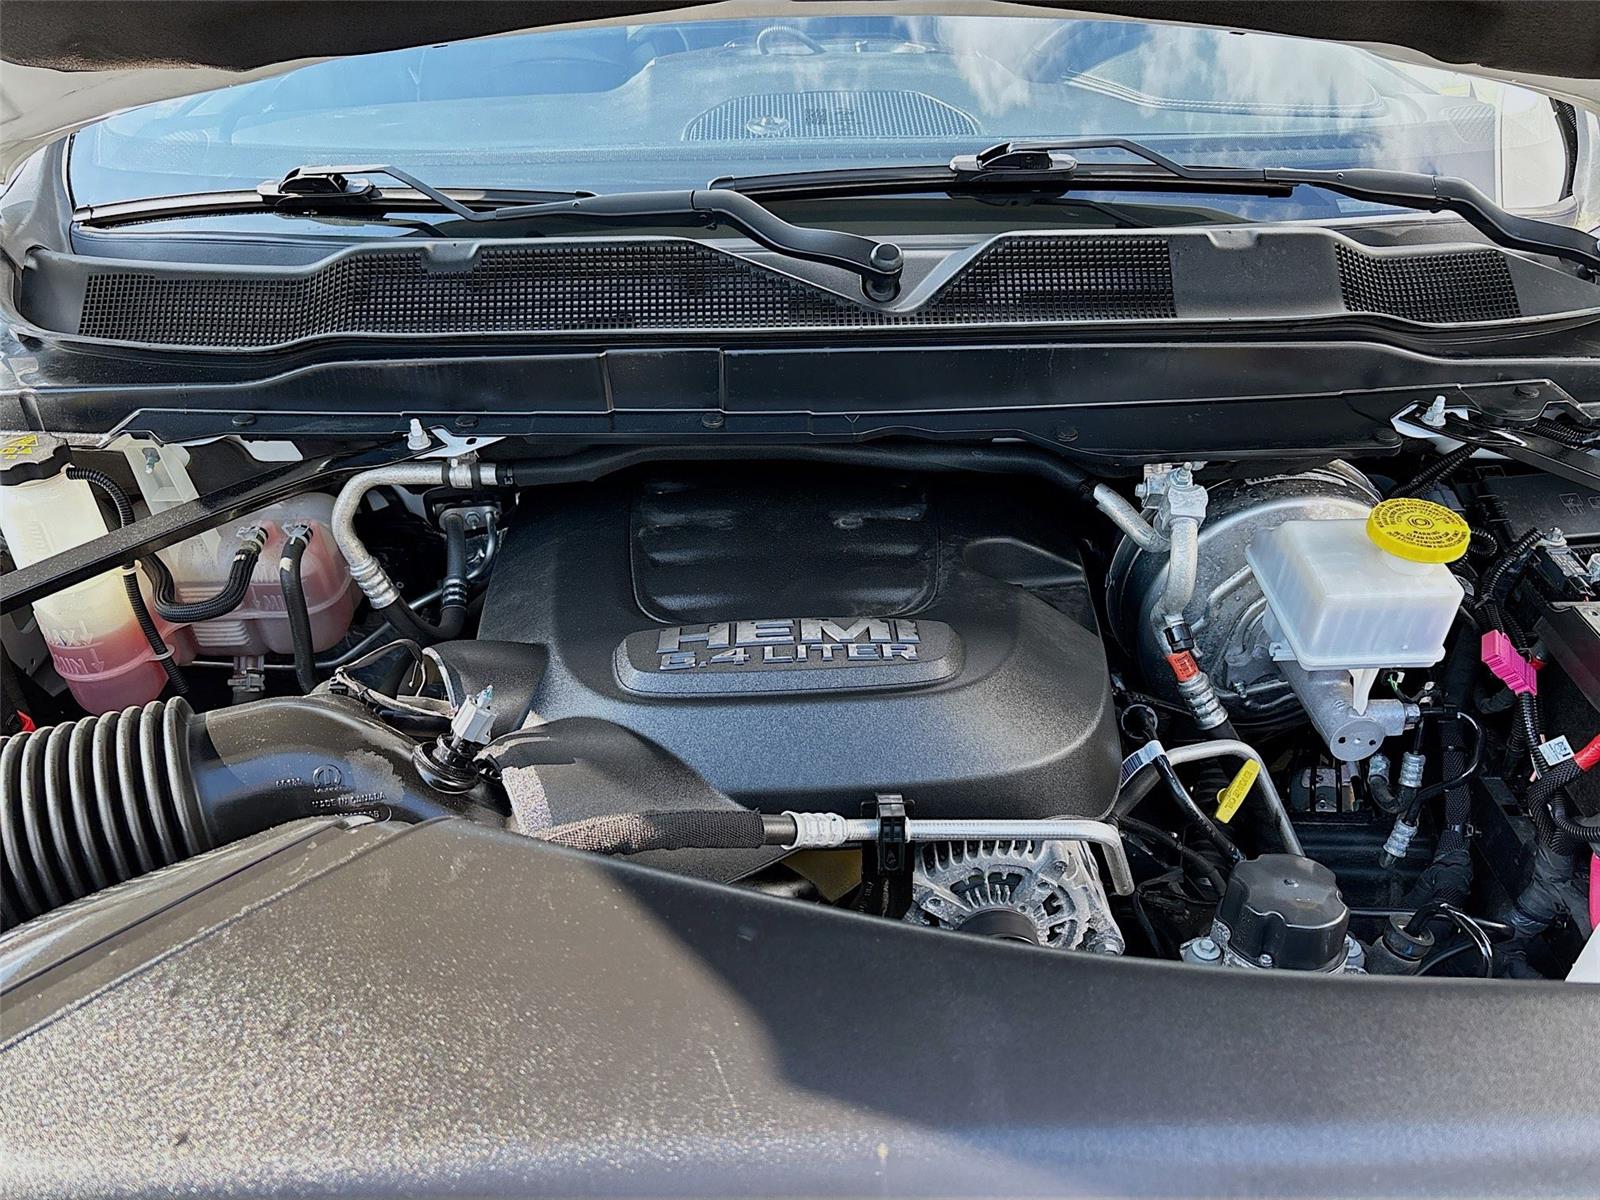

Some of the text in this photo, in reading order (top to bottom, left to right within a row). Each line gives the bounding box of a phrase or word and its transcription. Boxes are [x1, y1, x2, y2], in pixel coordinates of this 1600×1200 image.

[656, 617, 921, 654] HEMI
[659, 642, 920, 671] 6.4 LITER
